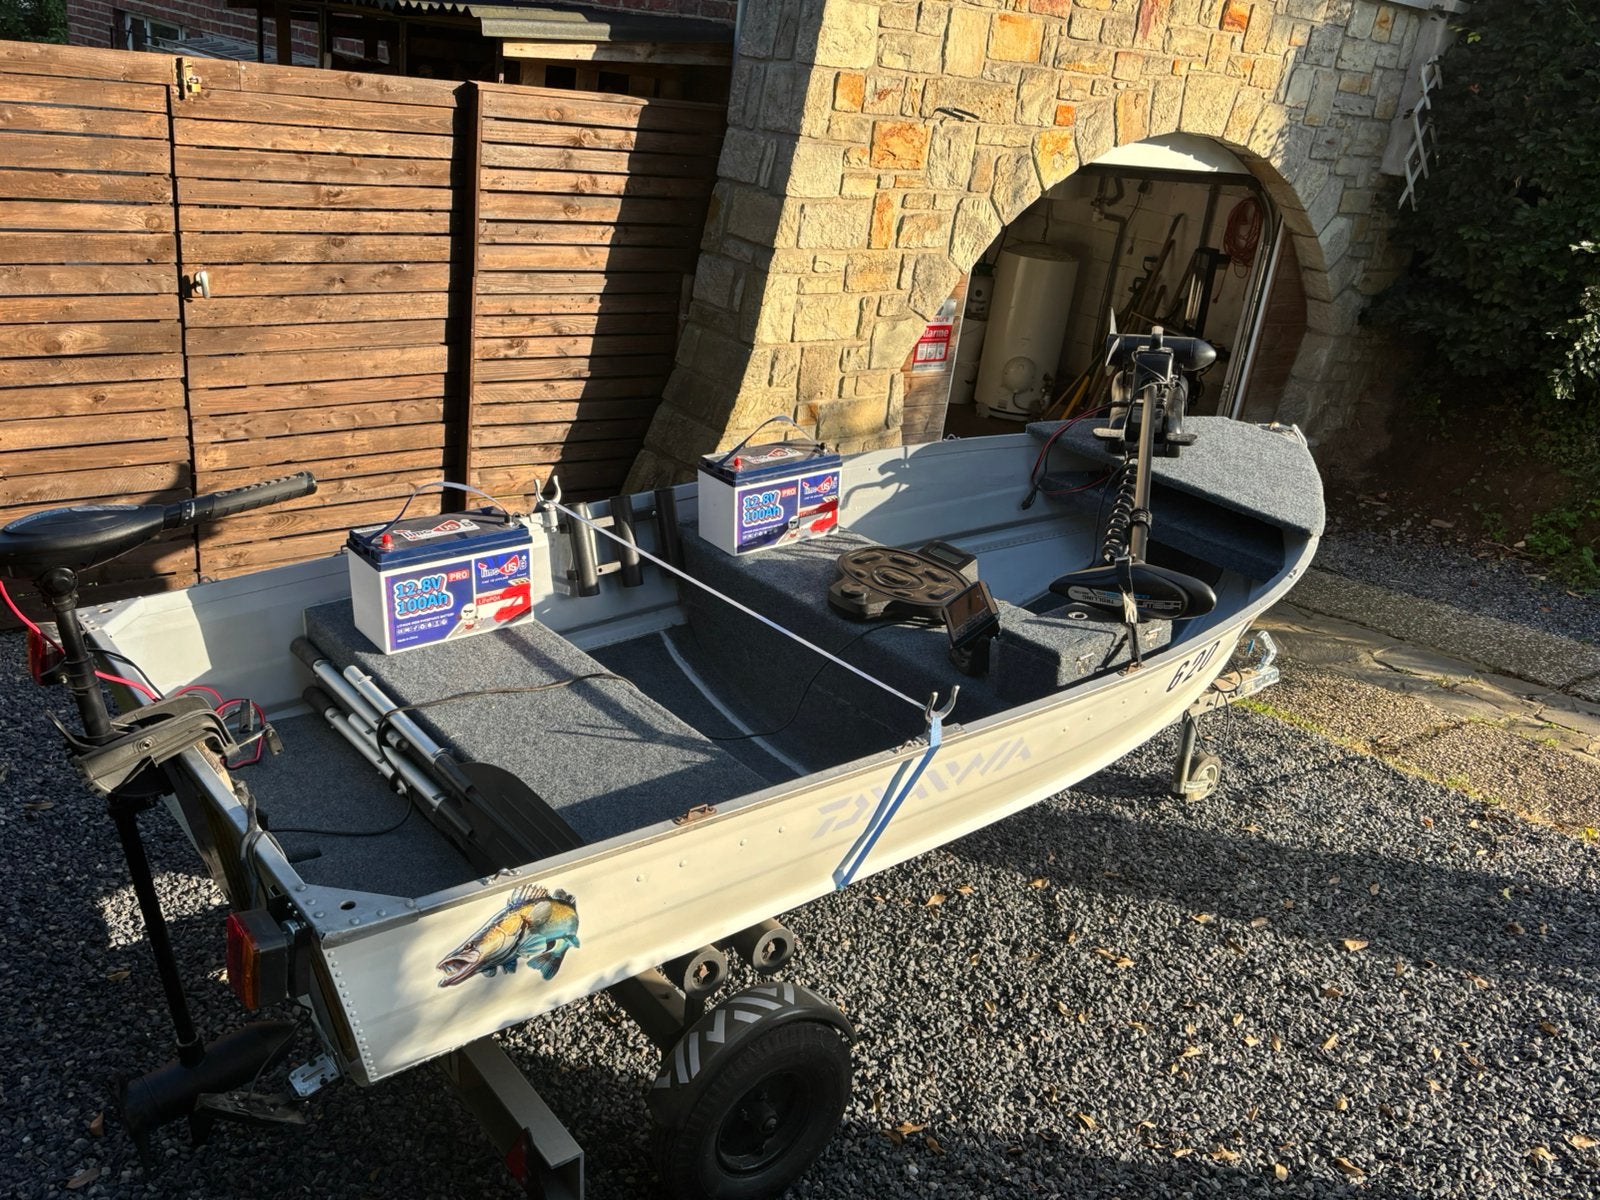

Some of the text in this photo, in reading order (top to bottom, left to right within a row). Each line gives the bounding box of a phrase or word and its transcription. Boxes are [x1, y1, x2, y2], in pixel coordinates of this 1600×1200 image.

[745, 491, 779, 510] 12.8V
[782, 488, 796, 497] PRO
[744, 504, 780, 524] 100Ah
[449, 571, 468, 580] PRO
[395, 574, 445, 600] 12.8V
[397, 591, 450, 617] 100Ah
[1166, 640, 1221, 693] 620
